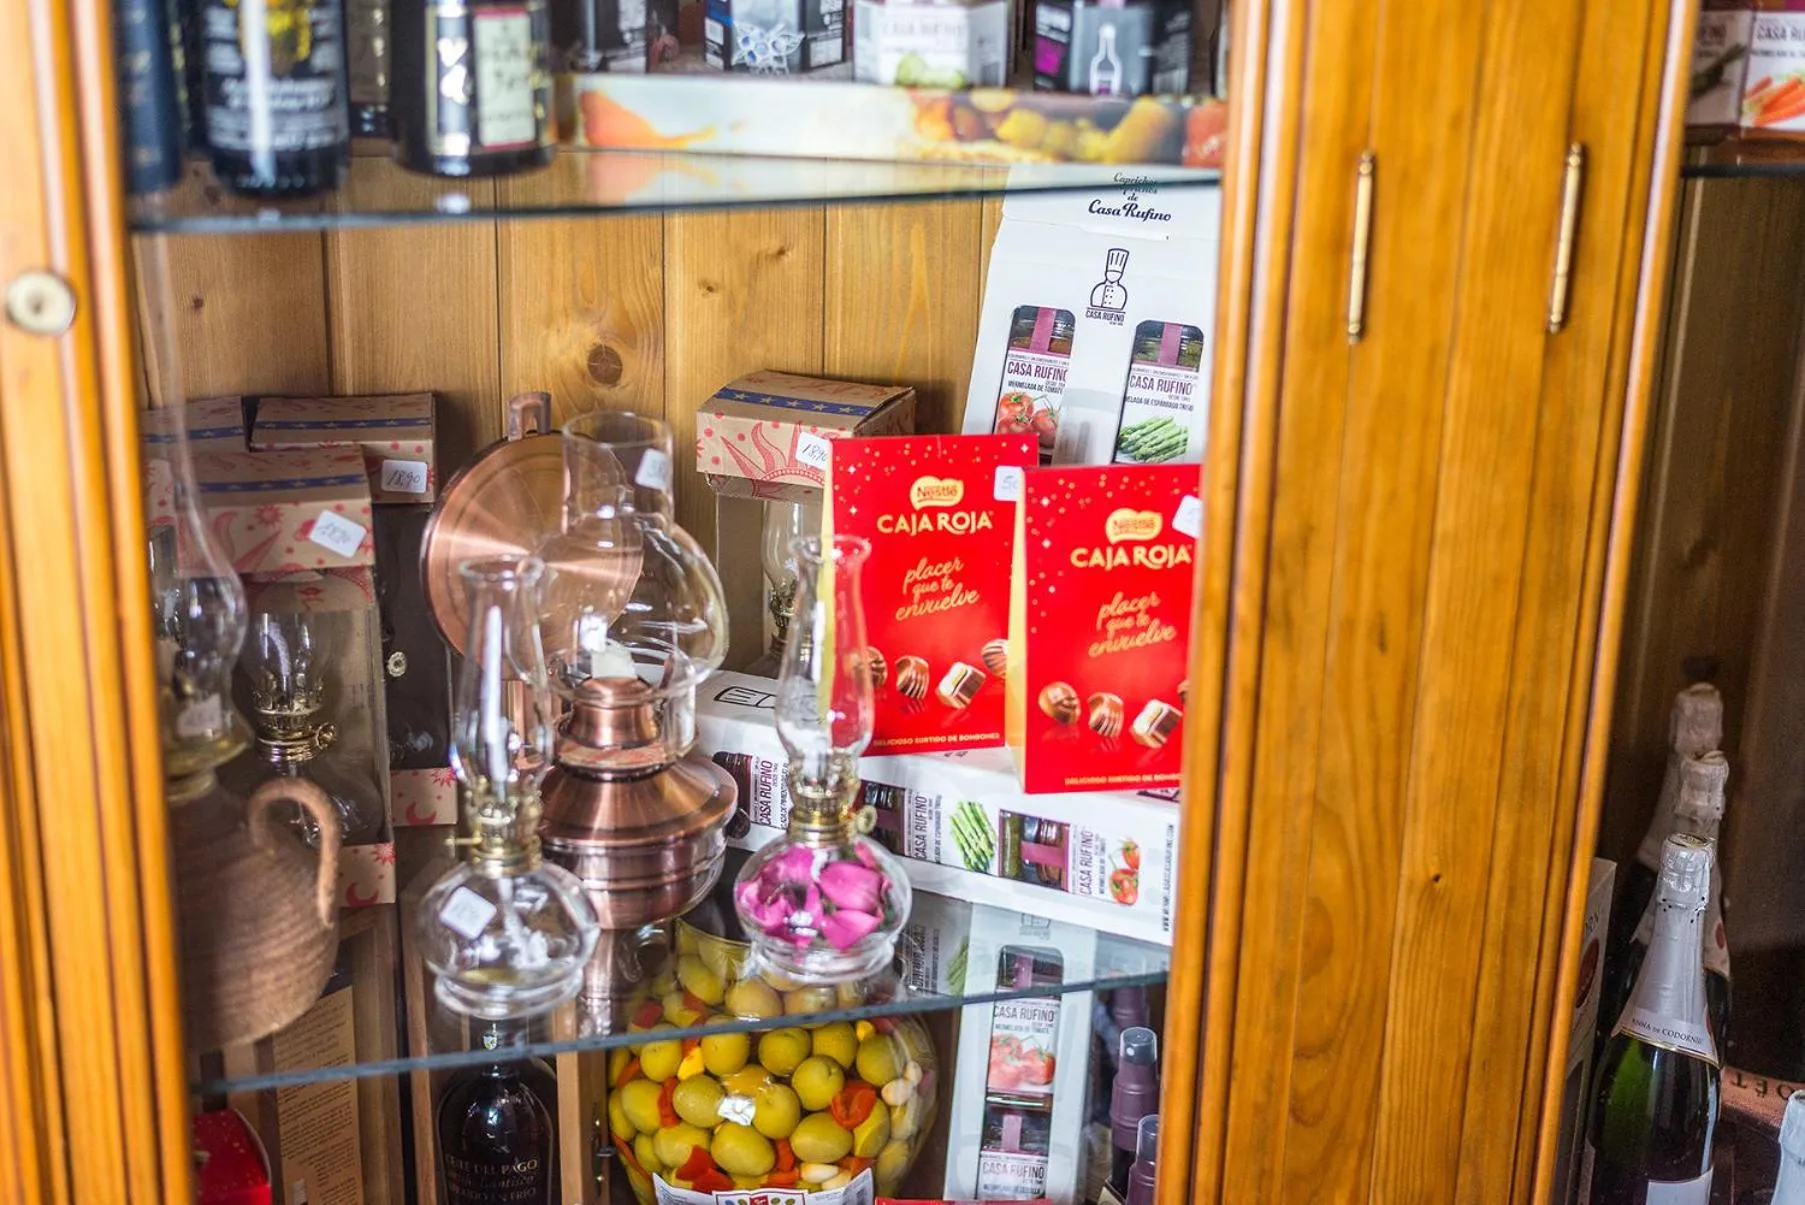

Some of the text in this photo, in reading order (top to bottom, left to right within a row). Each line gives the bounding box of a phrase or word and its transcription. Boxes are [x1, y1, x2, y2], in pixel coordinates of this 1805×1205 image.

[1088, 198, 1172, 222] Casa Rufino
[1085, 310, 1125, 322] CASA RUFINO
[1007, 361, 1032, 376] CASA
[1129, 375, 1194, 396] CASA RUFINO
[877, 511, 993, 537] CAJA ROJA
[1070, 545, 1192, 571] CAJA ROJA
[903, 557, 964, 595] placer
[912, 575, 955, 604] que te
[895, 583, 980, 621] envuelve
[1096, 591, 1161, 631] placer
[1088, 617, 1177, 658] envuelve
[1106, 610, 1150, 640] que te
[759, 760, 772, 826] CASA RUFINO
[914, 796, 927, 859] CASA RUFINO
[1080, 830, 1093, 894] CASA RUFINO
[994, 1004, 1018, 1019] CASA
[1020, 1007, 1055, 1023] RUFINO
[501, 1159, 538, 1175] PAGO
[983, 1161, 1046, 1180] CASA RUFINO
